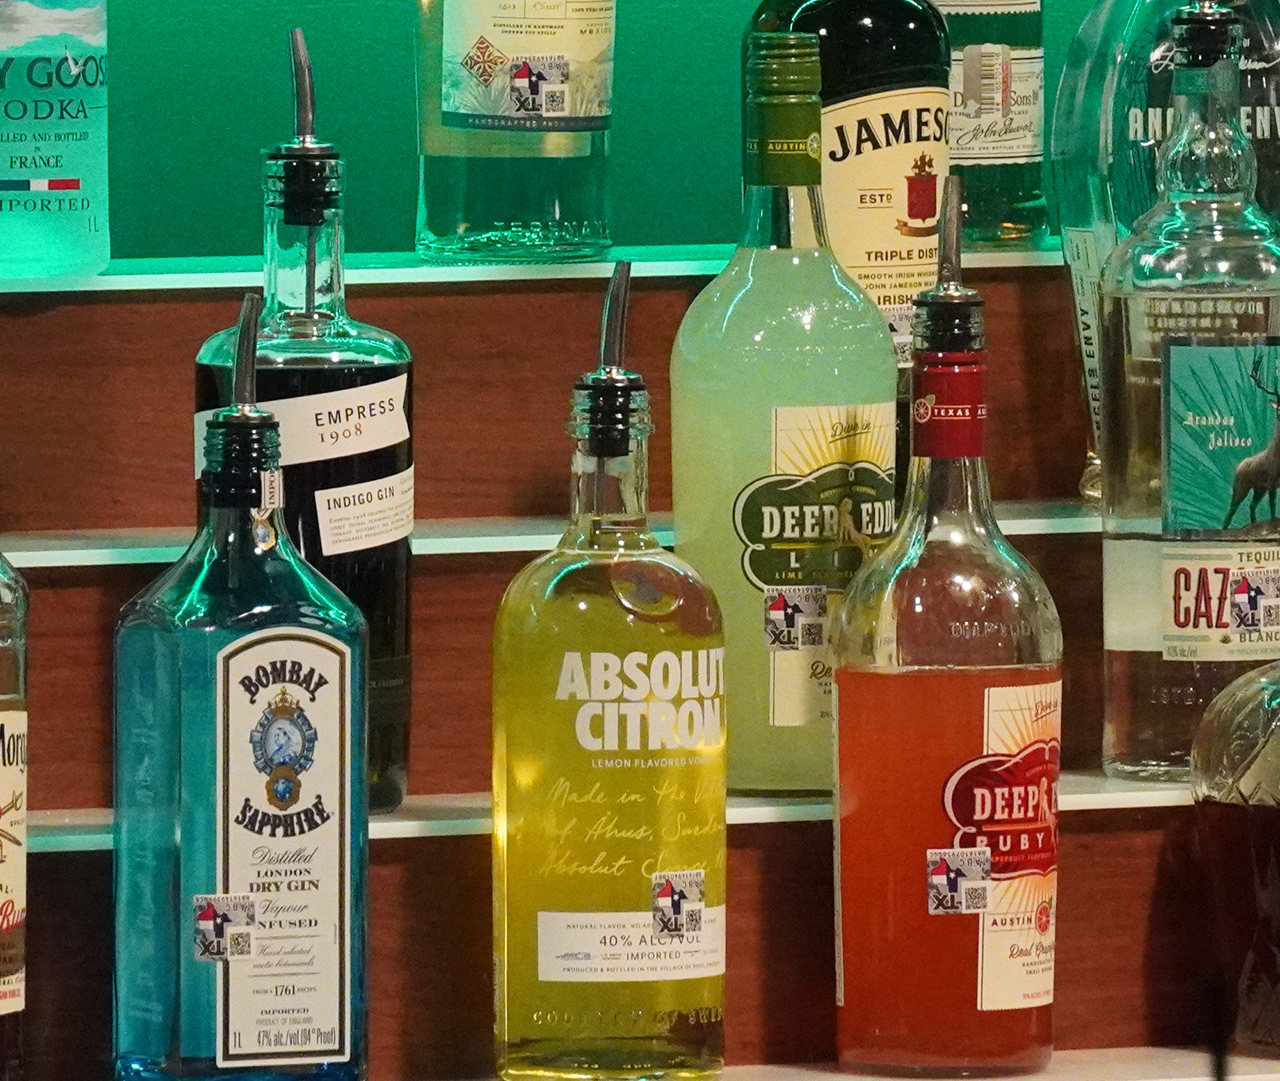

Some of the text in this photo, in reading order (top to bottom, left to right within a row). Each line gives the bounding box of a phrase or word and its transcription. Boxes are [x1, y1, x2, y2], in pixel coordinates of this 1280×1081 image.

[26, 55, 107, 92] GOOS
[32, 132, 52, 142] AND
[54, 131, 89, 142] BOTTLED
[768, 142, 806, 150] AUSTIN
[9, 155, 64, 169] FRANCE
[865, 249, 914, 262] TRIPLE
[889, 281, 922, 289] JAMESON
[877, 294, 913, 306] IRISH
[1079, 306, 1096, 359] ENVY
[314, 397, 396, 428] EMPRESS
[934, 408, 970, 416] TEXAS
[1182, 411, 1236, 428] Arandas
[320, 422, 364, 446] 1908
[830, 421, 857, 441] Dive
[1208, 429, 1253, 449] Jalisco
[326, 486, 394, 510] INDIGO GIN
[555, 645, 725, 701] ABSOLUT
[239, 659, 330, 705] BOMBAY
[574, 697, 722, 751] CITRON
[591, 757, 687, 769] LEMON FLAVORED
[548, 778, 645, 805] Made in
[973, 784, 1040, 821] DEEP
[233, 794, 333, 838] SAPPHIRE
[250, 846, 319, 866] Distilled
[538, 852, 635, 877] Absolut
[256, 868, 312, 878] LONDON
[248, 879, 321, 893] DRY GIN
[259, 899, 310, 918] Vapour
[566, 922, 627, 931] NATURAL FLAVOR
[991, 915, 1033, 928] AUSTIN
[599, 933, 633, 948] 40%
[625, 949, 681, 962] IMPORTED
[1008, 943, 1033, 959] Real
[562, 965, 599, 974] PRODUCED
[274, 985, 296, 997] 1761
[260, 1007, 310, 1016] IMPORTED
[233, 1030, 272, 1048] 1L 47%
